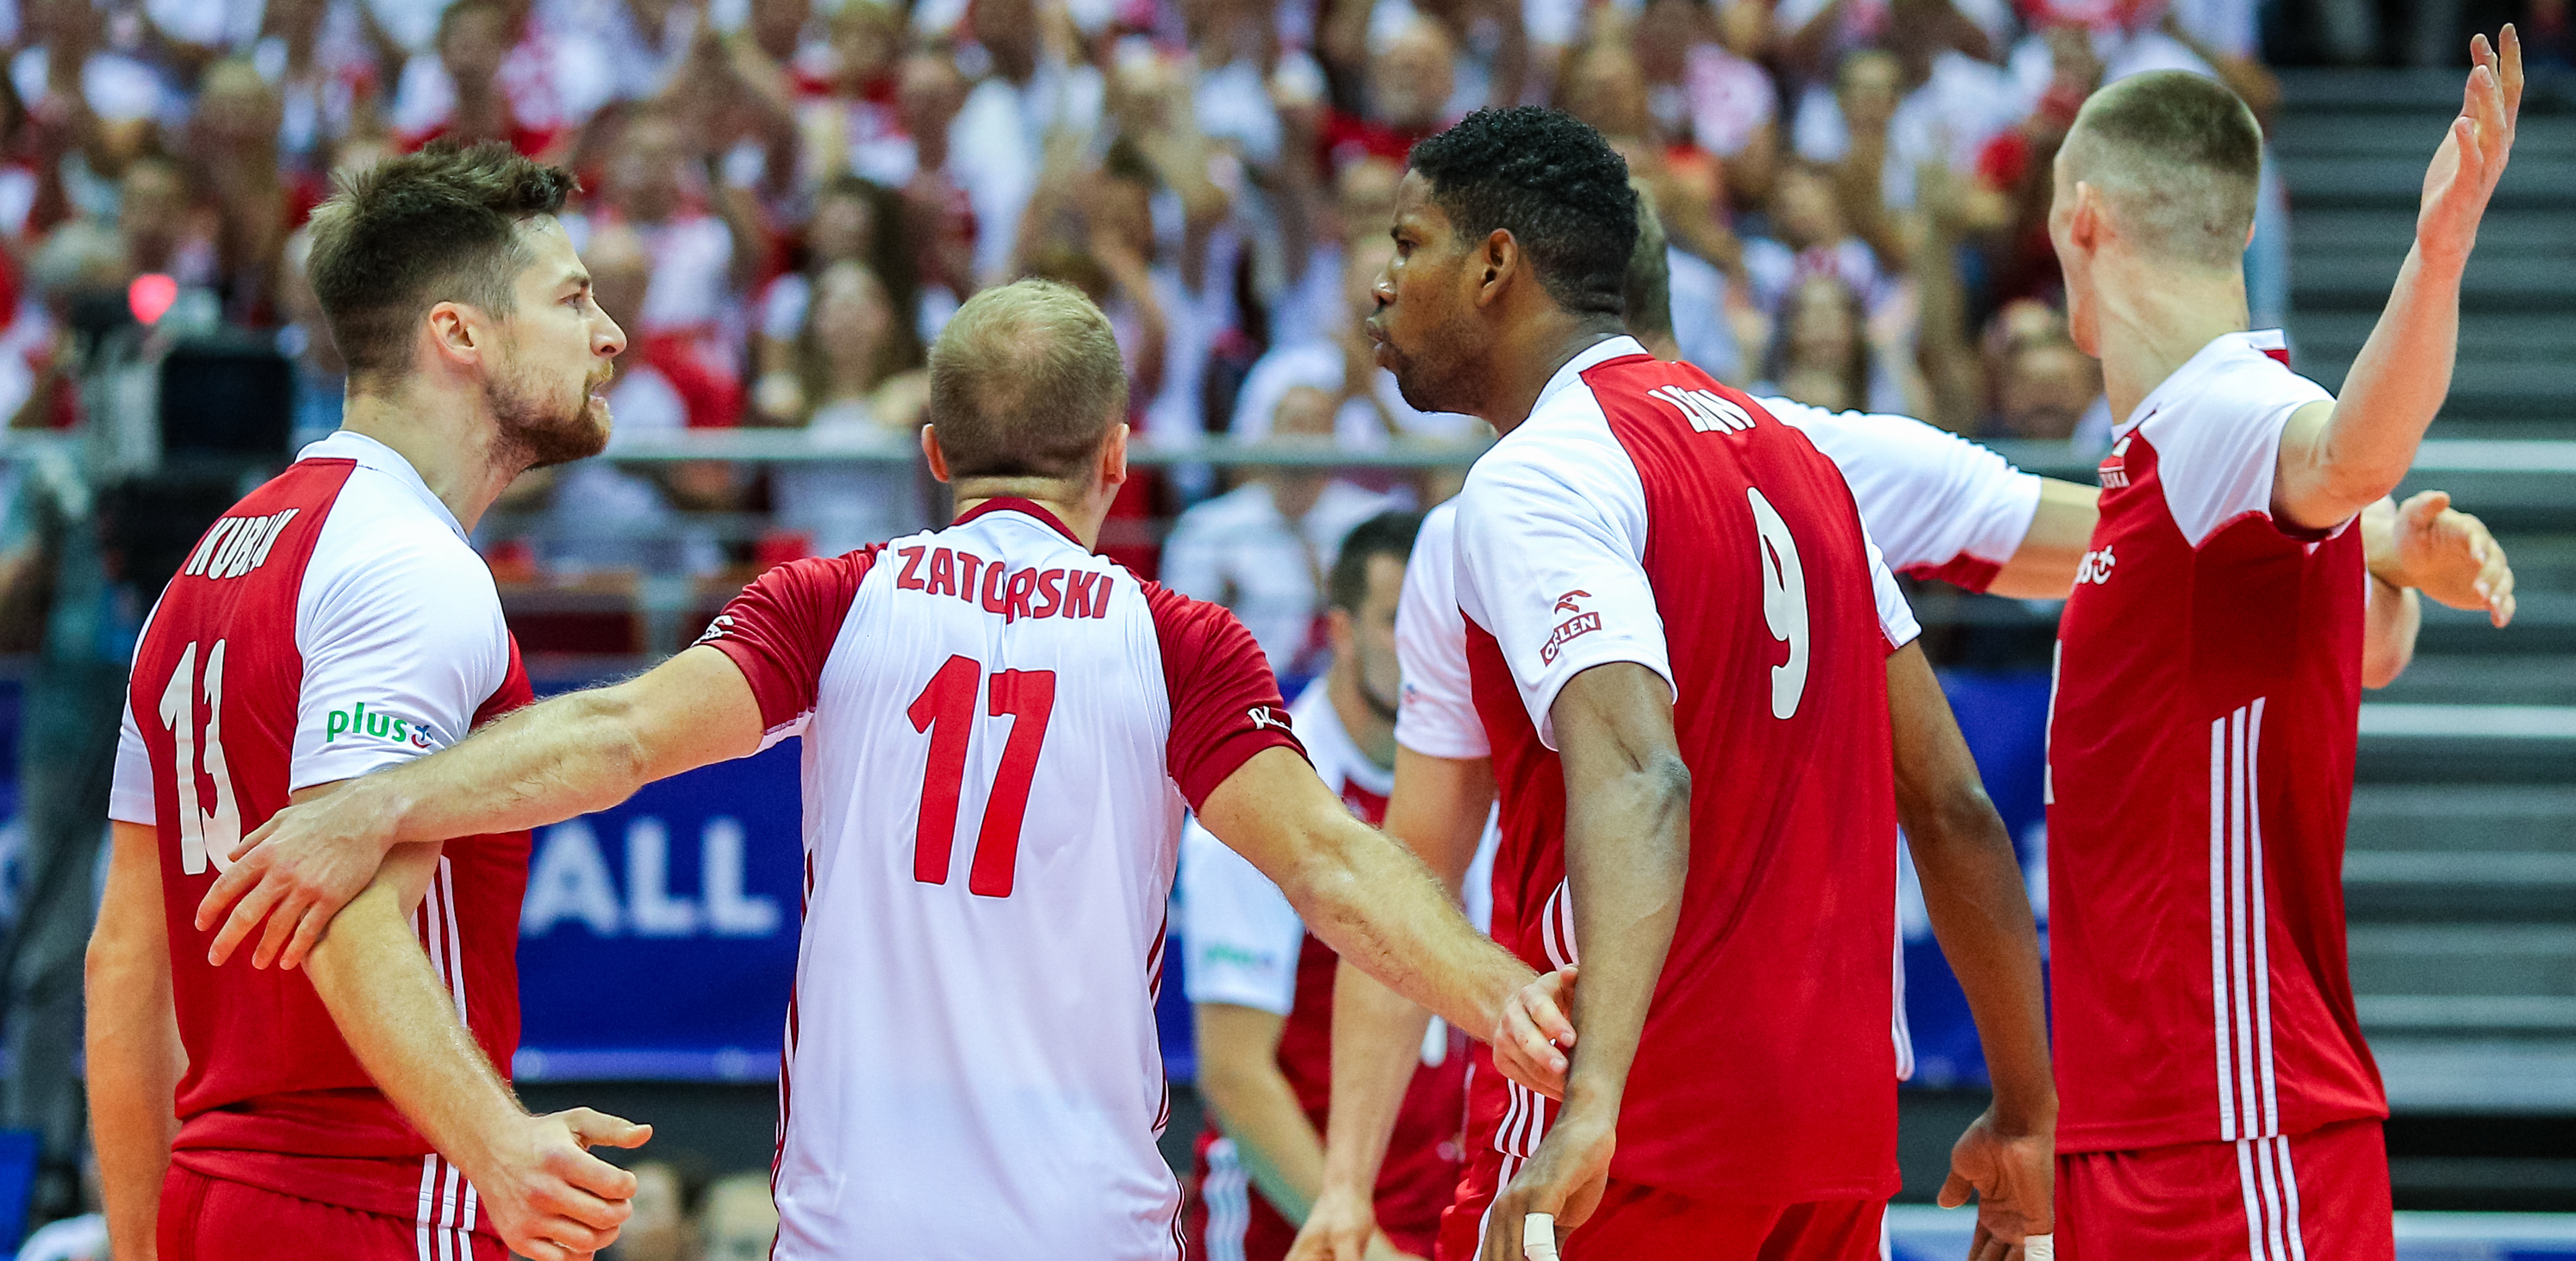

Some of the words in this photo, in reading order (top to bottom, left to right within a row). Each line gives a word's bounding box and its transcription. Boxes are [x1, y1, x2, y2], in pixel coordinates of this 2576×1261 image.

[897, 546, 1114, 624] ZATORSKI
[1746, 487, 1809, 719] 9
[159, 638, 241, 875] 13
[327, 701, 408, 742] plus
[906, 654, 1056, 898] 17
